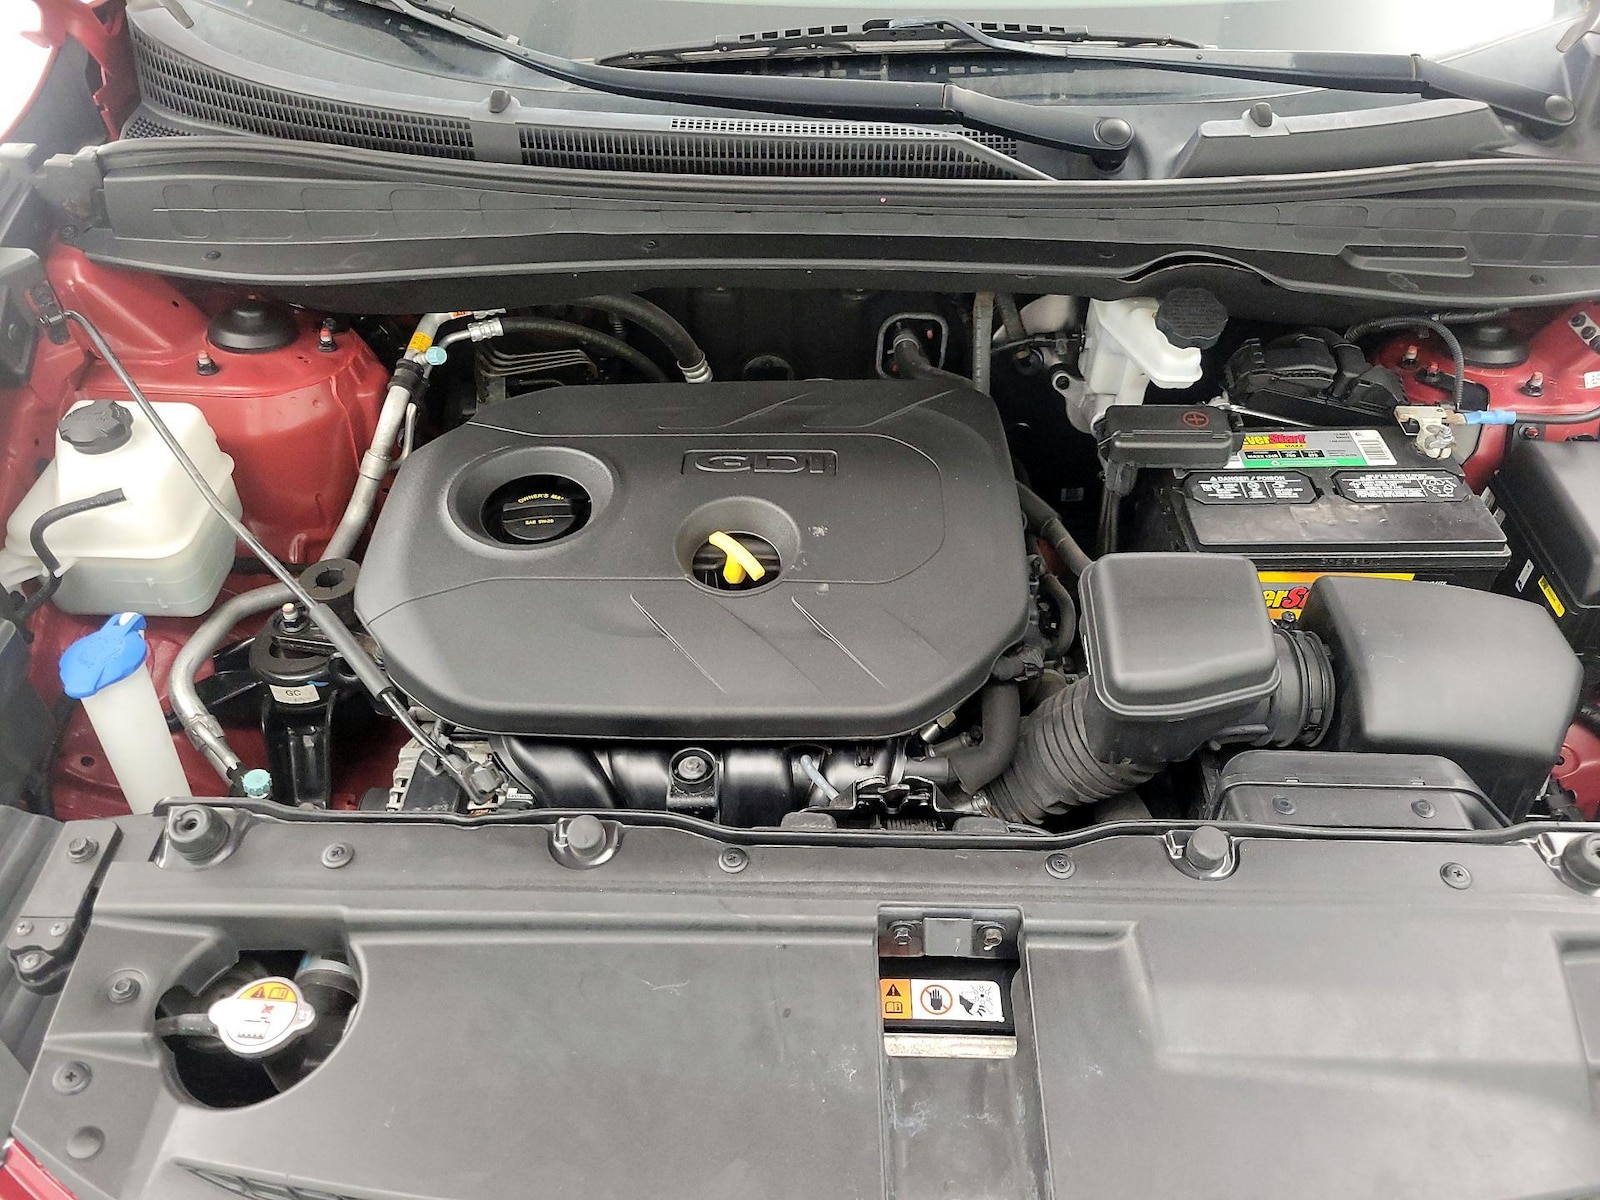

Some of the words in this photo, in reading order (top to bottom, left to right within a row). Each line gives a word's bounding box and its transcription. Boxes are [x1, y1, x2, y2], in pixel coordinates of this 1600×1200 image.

[695, 455, 824, 473] GDI
[517, 493, 549, 504] OWNER'S
[285, 689, 302, 697] GC
